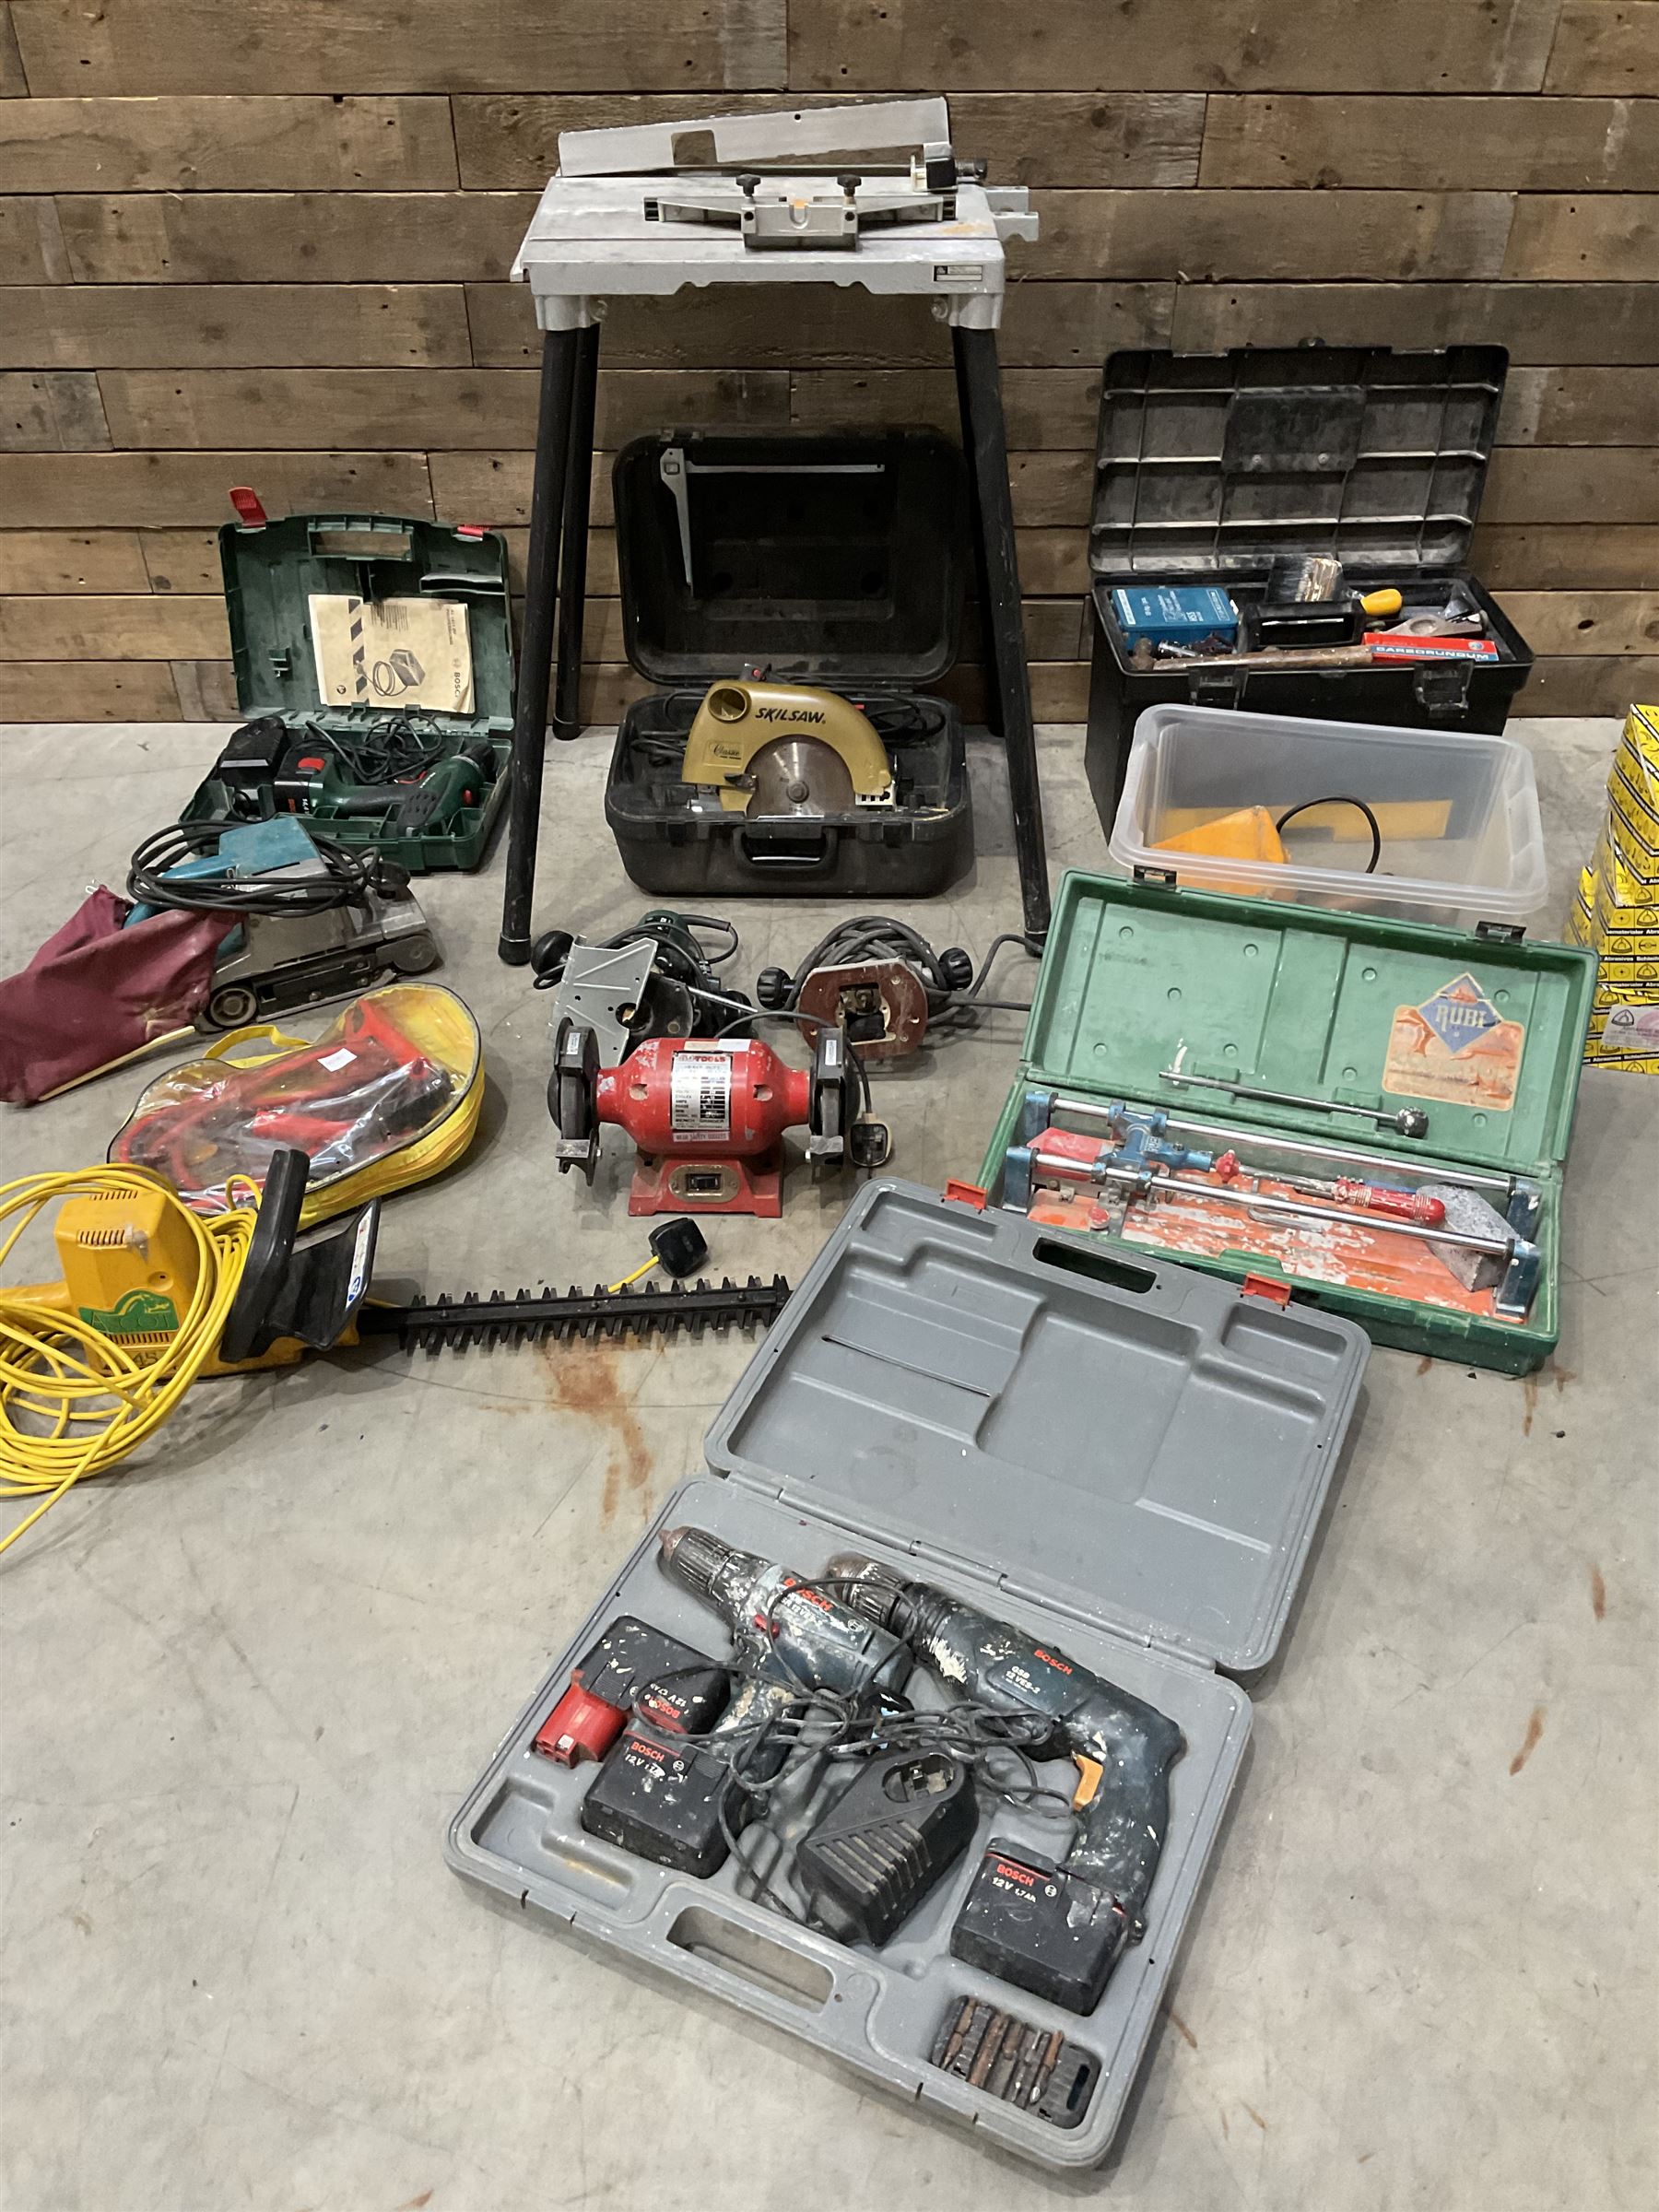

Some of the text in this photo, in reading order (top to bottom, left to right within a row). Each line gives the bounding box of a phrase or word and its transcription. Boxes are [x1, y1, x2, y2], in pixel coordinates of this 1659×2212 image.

[1435, 1004, 1487, 1032] RUBI
[1034, 1649, 1073, 1675] BOSCH
[630, 1741, 665, 1762] BOSCH
[996, 1864, 1035, 1887] BOSCH
